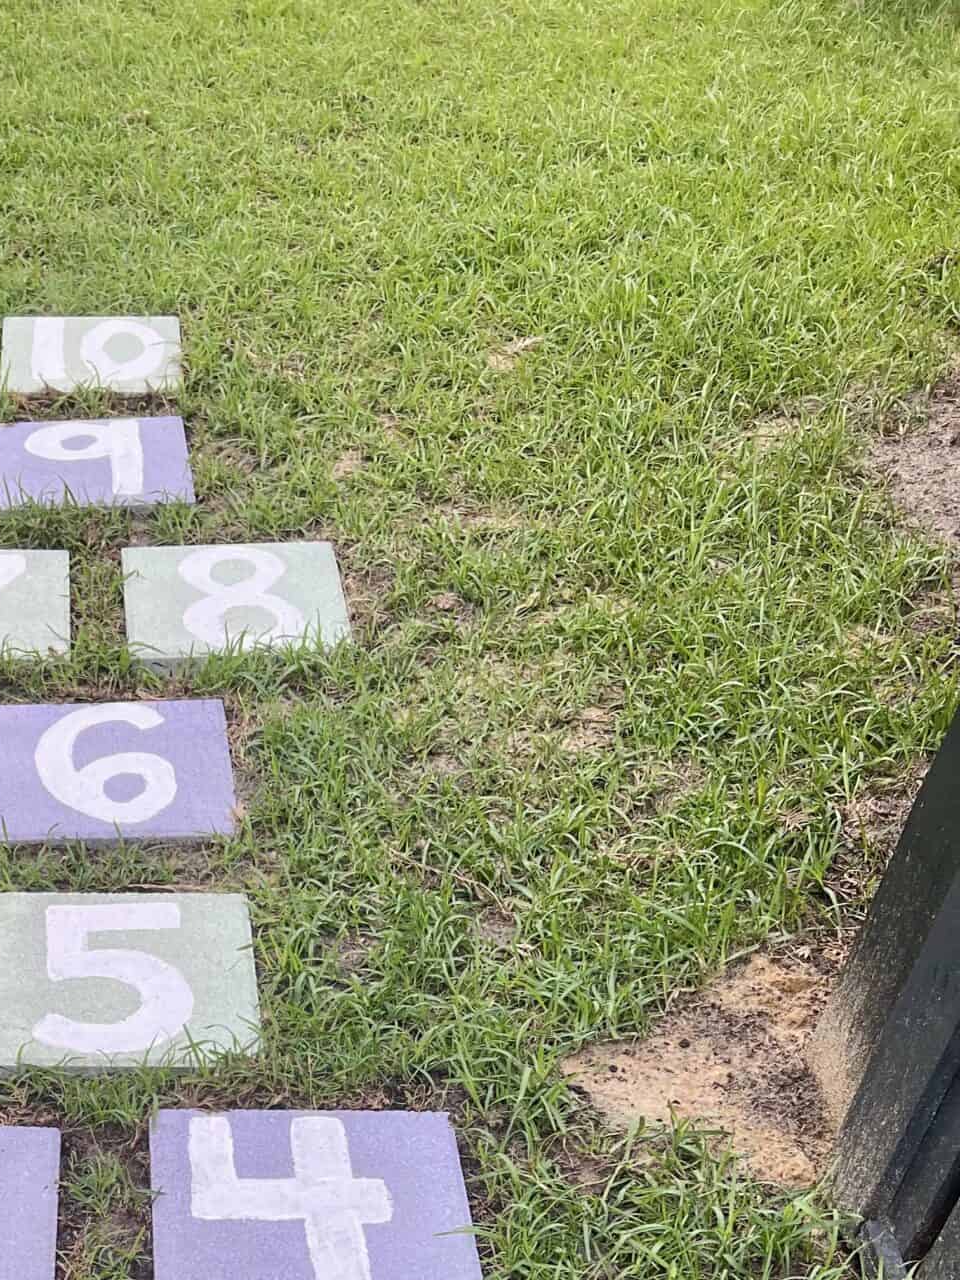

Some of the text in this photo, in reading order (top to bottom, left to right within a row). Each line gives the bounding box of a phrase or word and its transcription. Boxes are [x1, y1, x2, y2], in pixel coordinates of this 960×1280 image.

[31, 317, 165, 381] 10
[24, 418, 143, 495] 9
[178, 546, 306, 648] 8
[34, 702, 177, 824] 6
[32, 902, 195, 1053] 5
